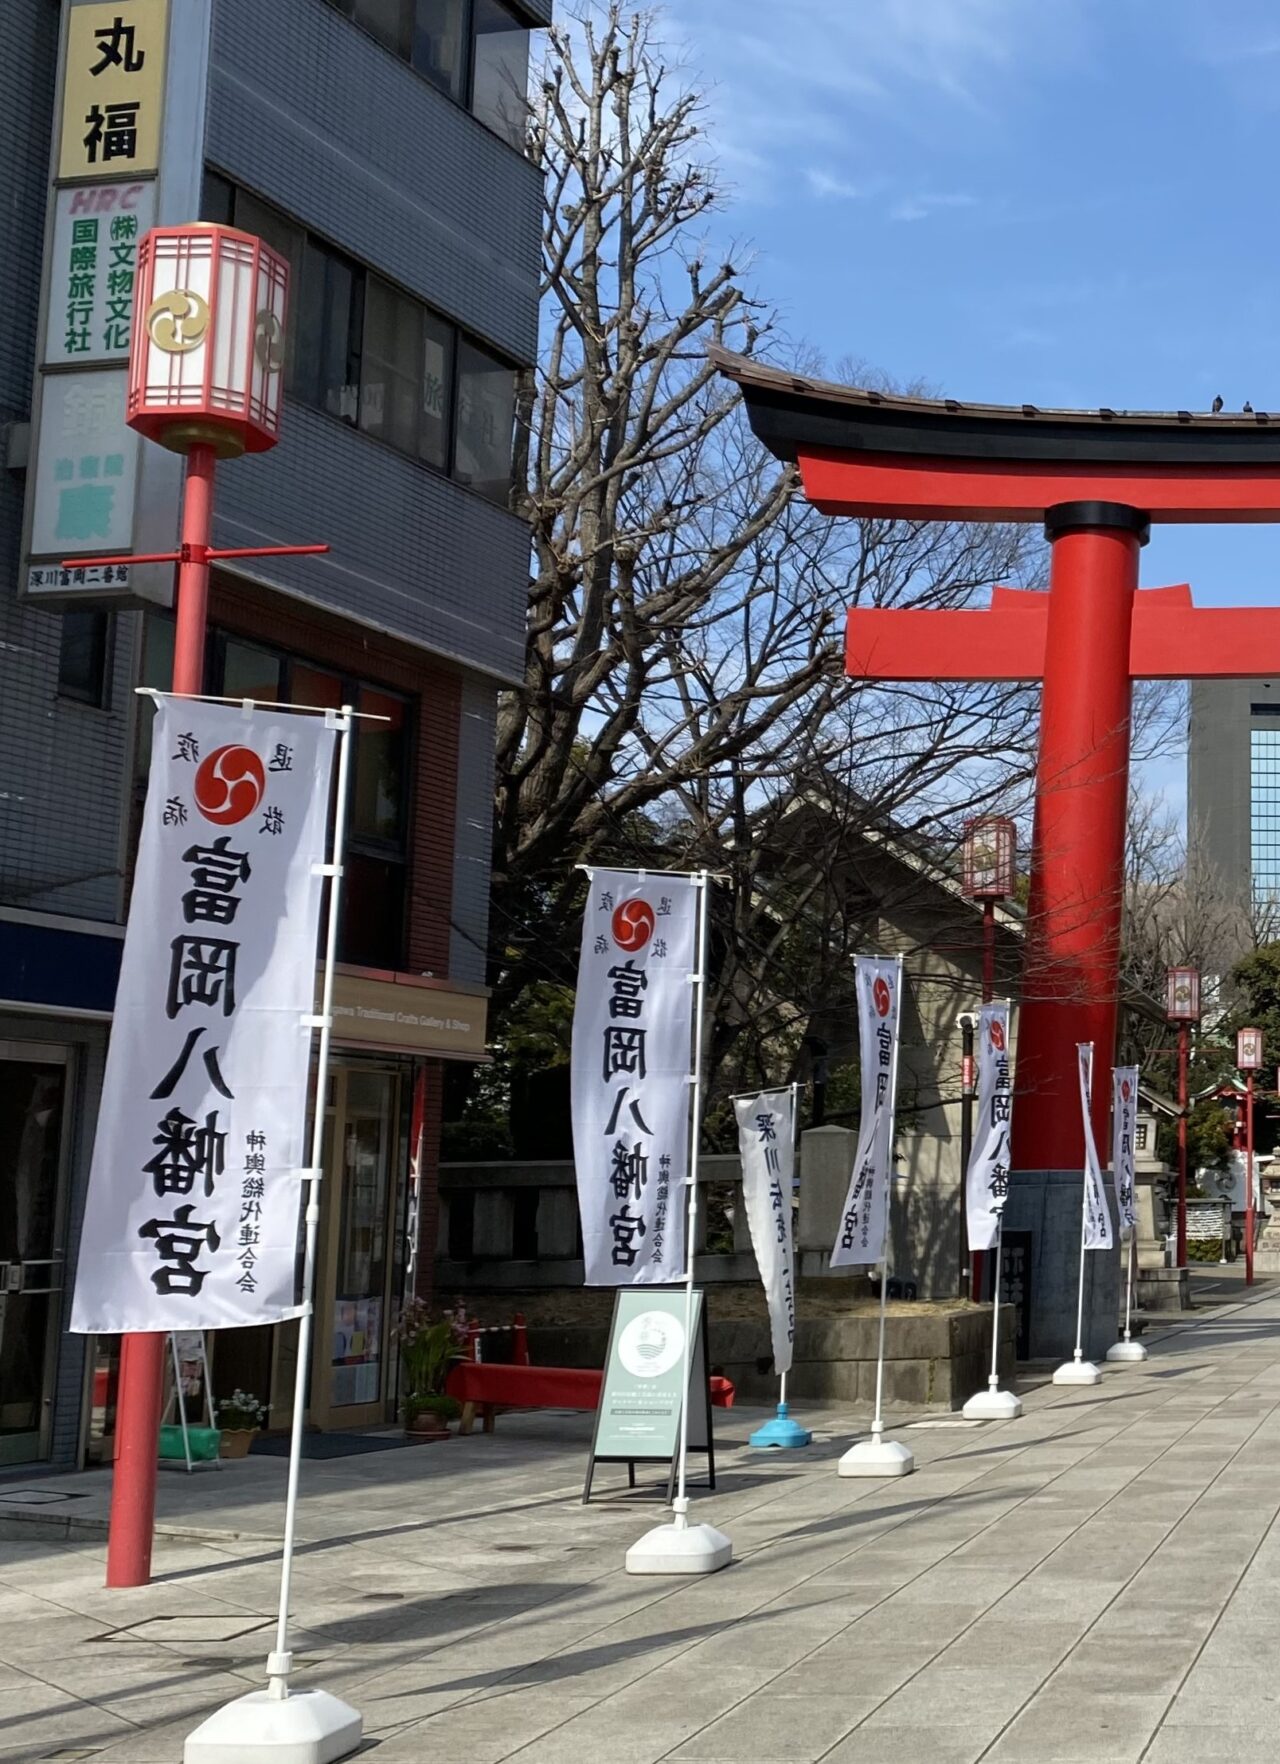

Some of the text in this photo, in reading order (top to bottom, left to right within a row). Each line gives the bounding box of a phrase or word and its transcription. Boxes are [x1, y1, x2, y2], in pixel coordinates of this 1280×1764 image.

[83, 17, 145, 162] 丸福
[64, 219, 99, 353] 国際旅行社
